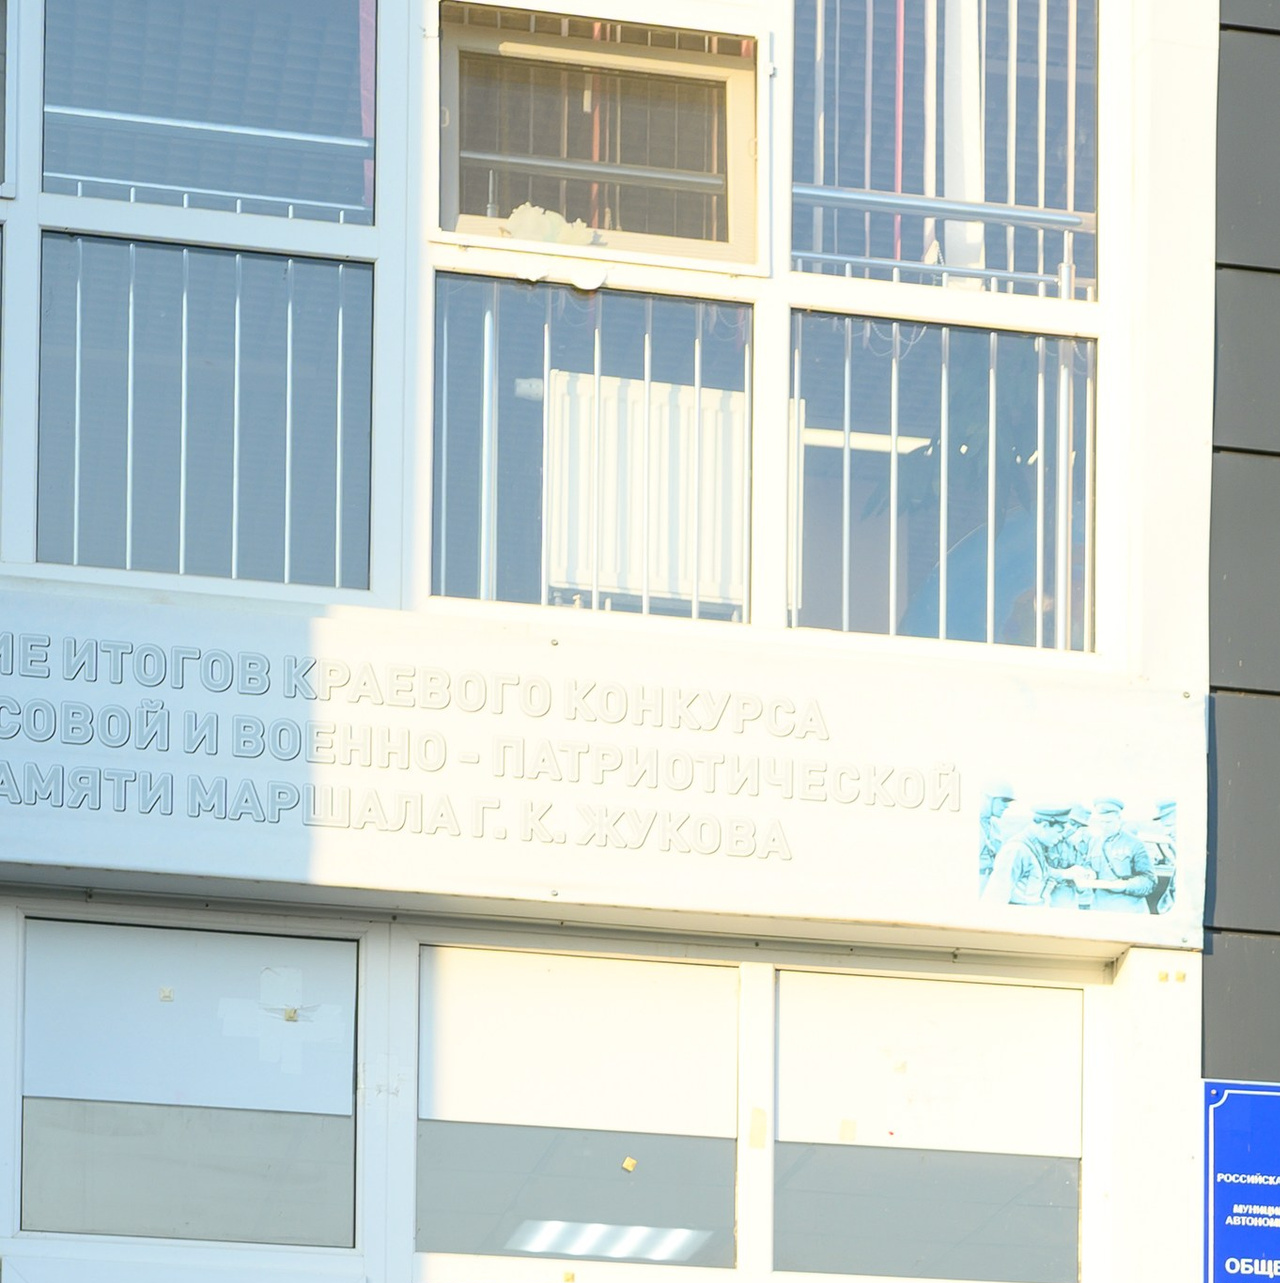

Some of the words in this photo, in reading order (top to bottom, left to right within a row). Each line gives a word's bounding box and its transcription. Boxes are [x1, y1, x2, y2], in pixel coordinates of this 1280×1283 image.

[62, 637, 272, 696] ИТОГОВ
[283, 654, 553, 719] КРАЕВОГО
[563, 677, 830, 742] КОНКУРСА
[183, 710, 219, 757] И
[231, 715, 447, 774] ВОЕННО
[491, 732, 963, 813] ПАТРИОТИЧЕСКОЙ
[186, 775, 461, 838] МАРШАЛА
[519, 800, 568, 845] К.
[575, 803, 793, 861] ЖУКОВА
